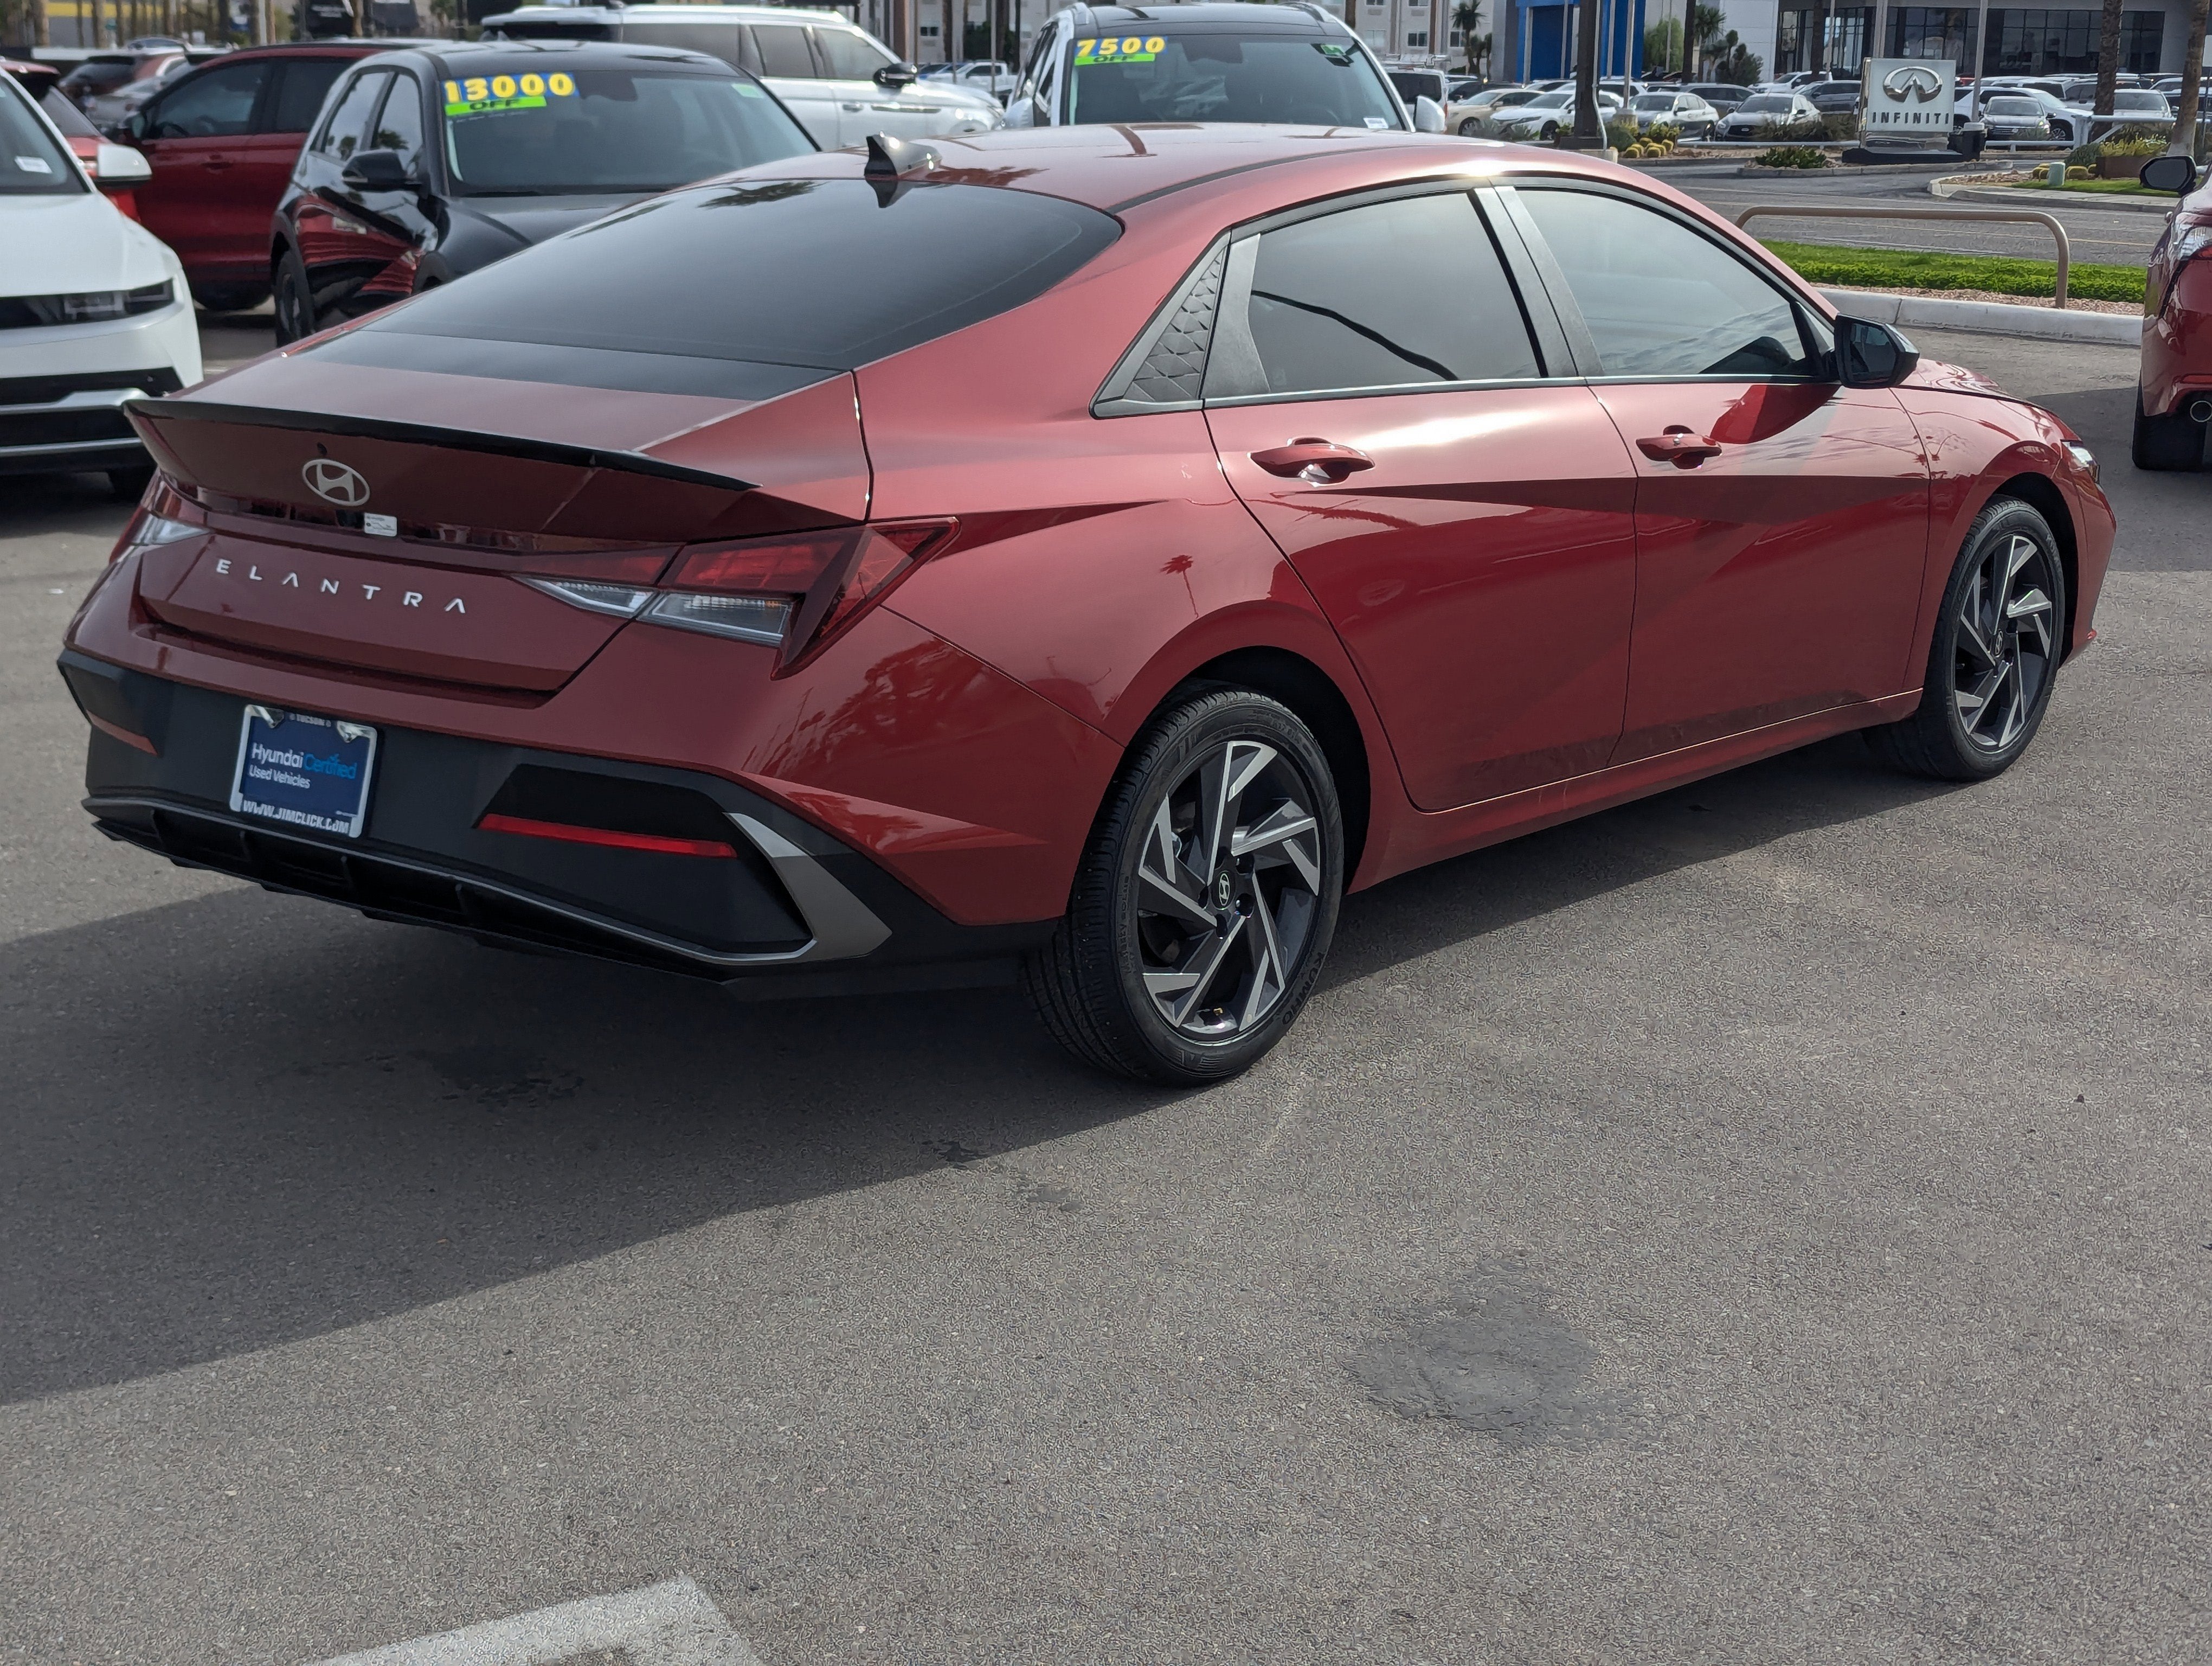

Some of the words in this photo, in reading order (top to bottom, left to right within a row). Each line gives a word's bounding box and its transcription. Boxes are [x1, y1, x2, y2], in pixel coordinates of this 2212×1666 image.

[1077, 37, 1165, 57] 7500
[444, 72, 574, 104] 13000
[470, 99, 519, 110] OFF
[1872, 112, 1949, 124] INFINITI
[216, 559, 466, 614] ELANTRA
[251, 742, 304, 768] Hyundai
[303, 753, 357, 779] Certified
[249, 764, 273, 780] Used
[272, 768, 311, 789] Vehicles
[1282, 951, 1326, 1025] KUMHO
